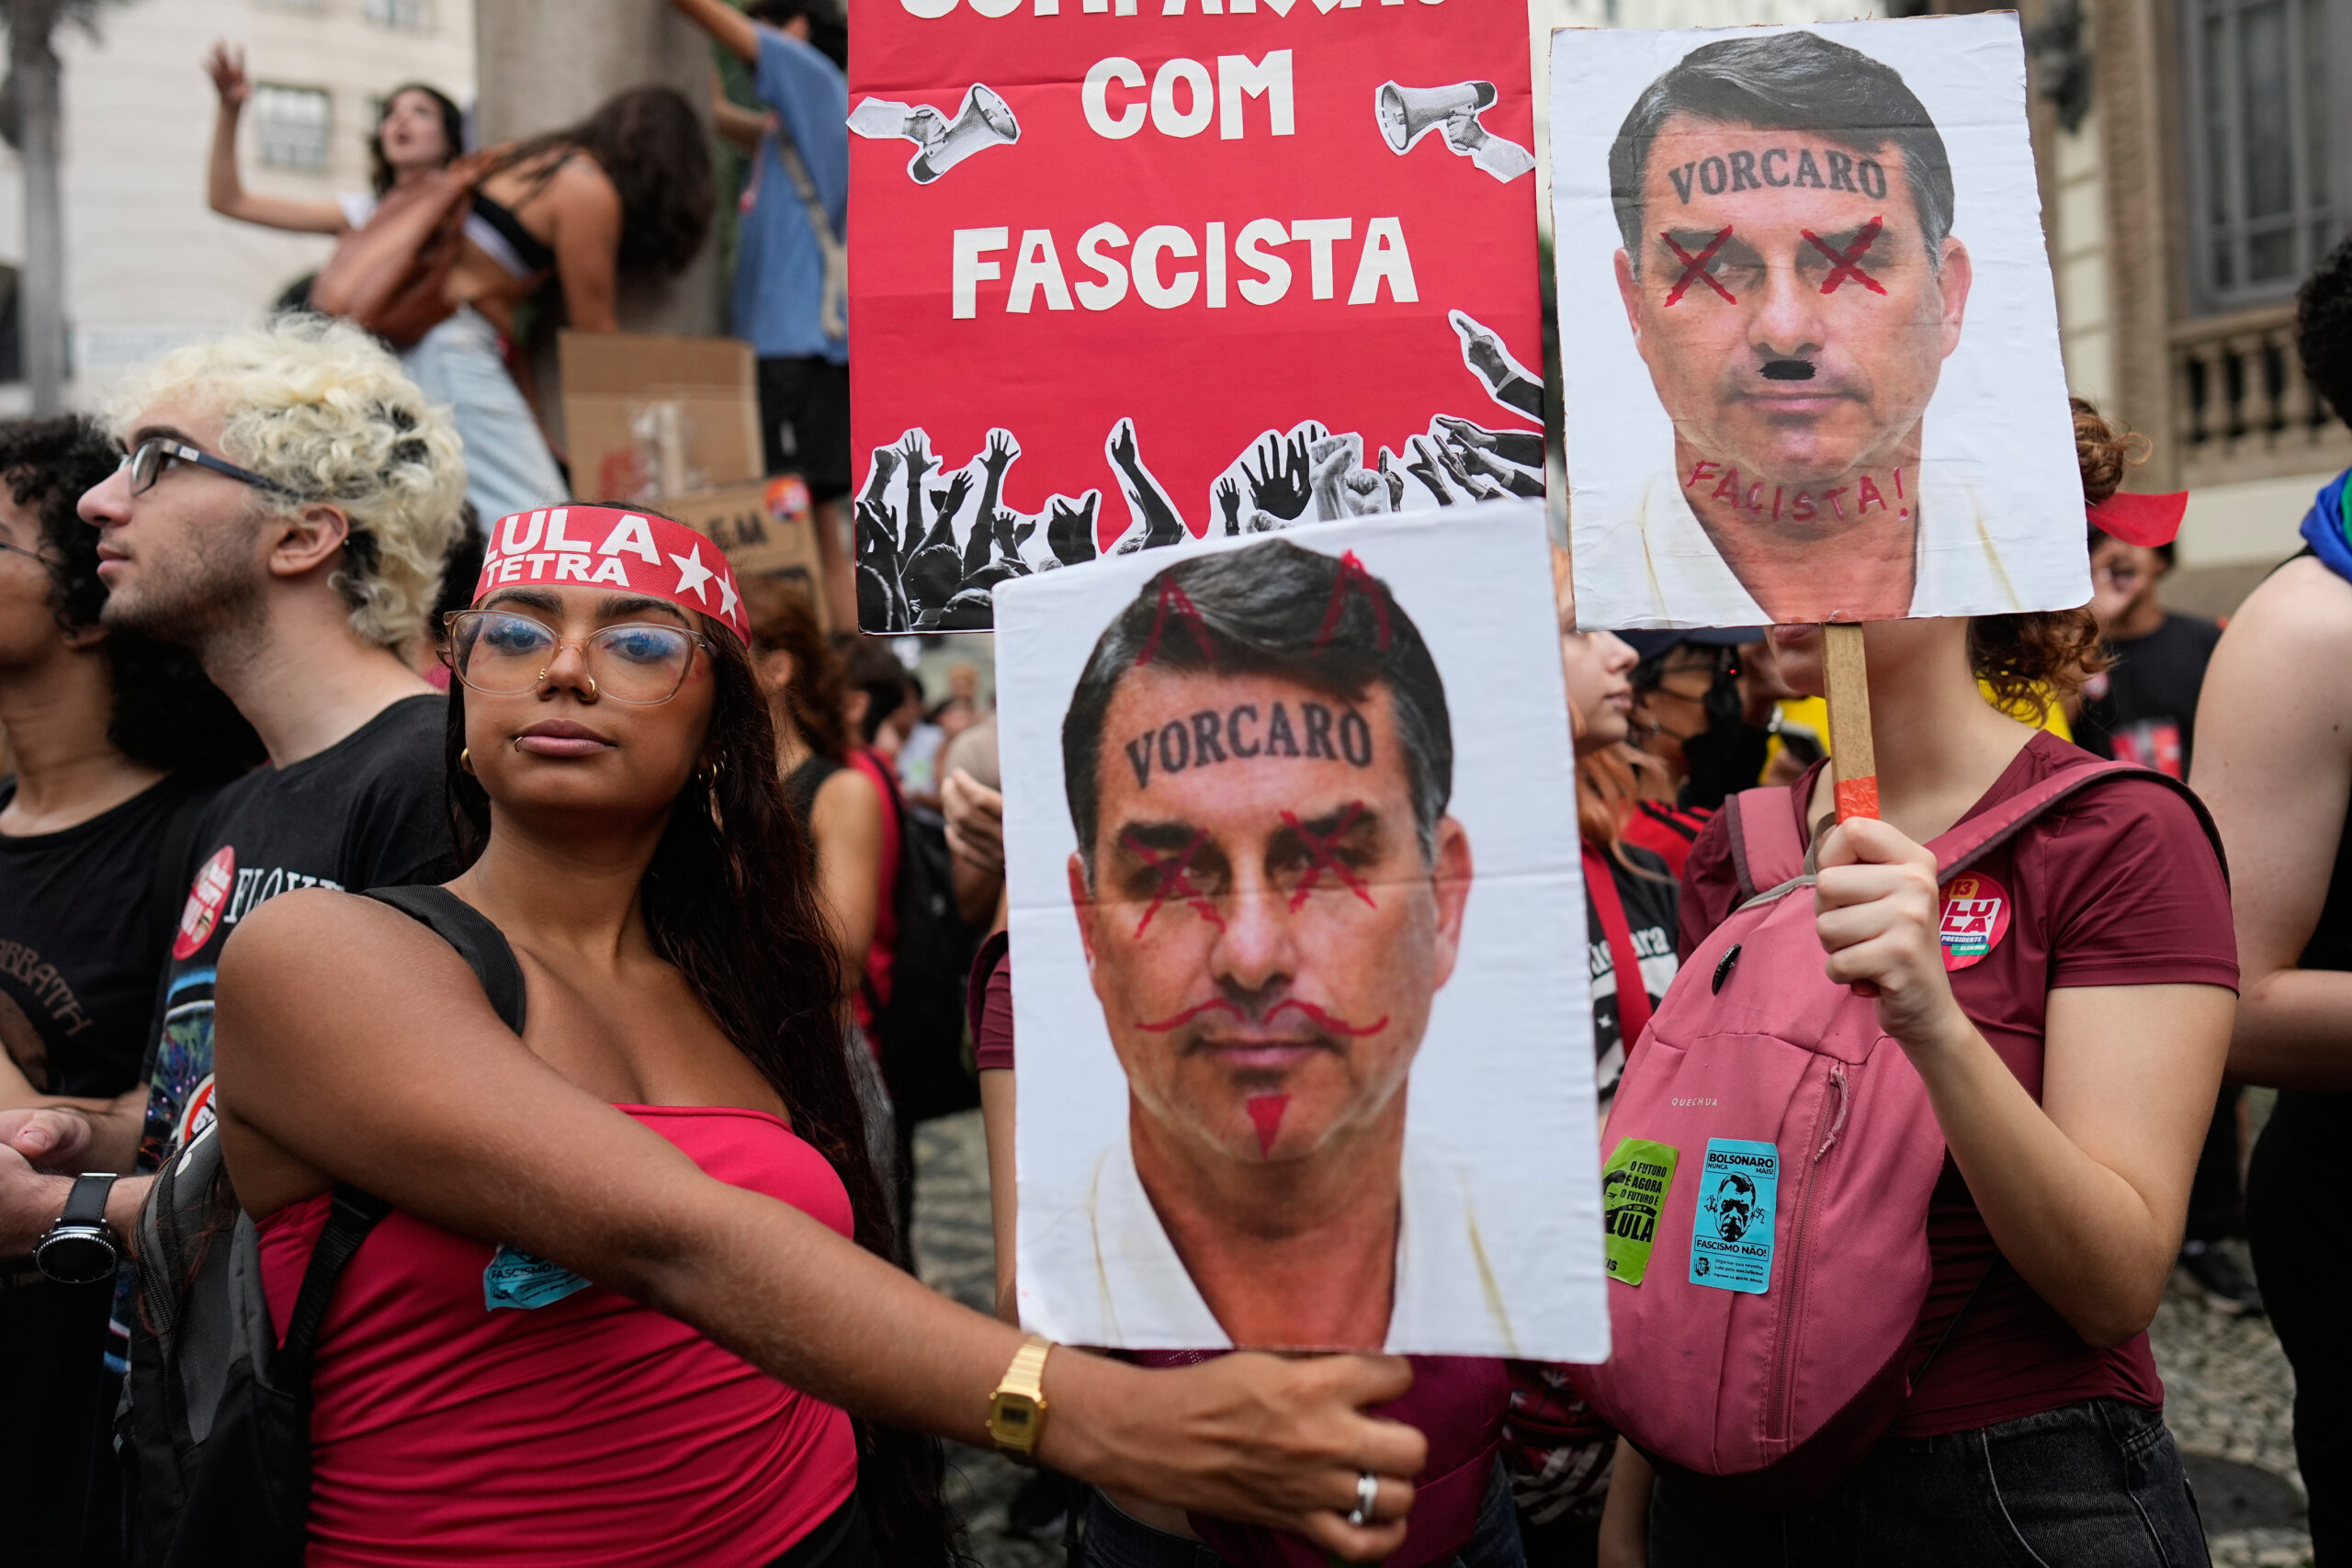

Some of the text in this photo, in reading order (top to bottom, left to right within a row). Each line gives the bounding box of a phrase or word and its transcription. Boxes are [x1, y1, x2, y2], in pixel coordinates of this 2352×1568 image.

[1081, 49, 1295, 141] COM
[1668, 148, 1887, 205] VORCARO
[952, 216, 1419, 320] FASCISTA
[1685, 460, 1910, 522] FACISTA!
[486, 553, 630, 589] TETRA
[1125, 701, 1373, 790] VORCARO
[1952, 881, 1973, 896] 13
[1671, 1097, 1718, 1107] QUECHUA
[1630, 1161, 1668, 1178] O FUTURO
[1709, 1153, 1774, 1168] BOLSONARO
[1624, 1173, 1663, 1193] É AGORA
[1620, 1189, 1660, 1206] O FUTURO É
[1696, 1239, 1768, 1258] FASCISMO NÃO!
[492, 1263, 551, 1280] FASCISMO
